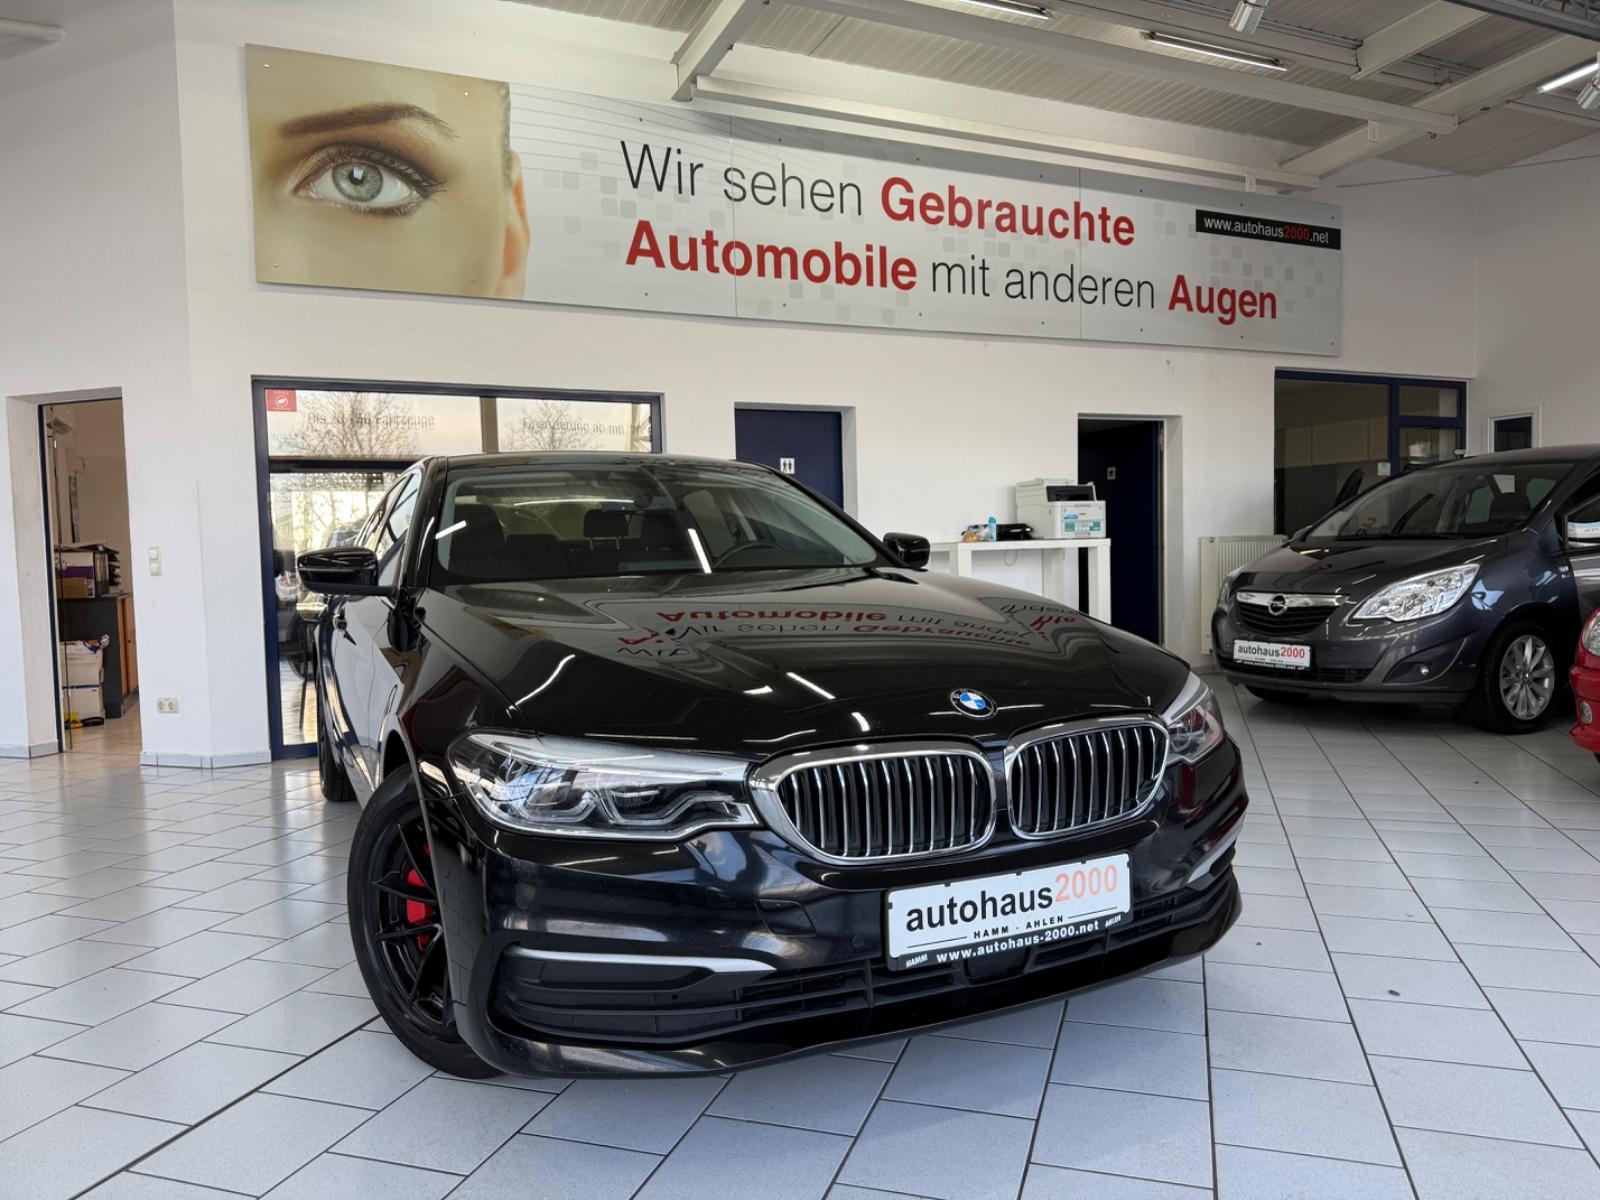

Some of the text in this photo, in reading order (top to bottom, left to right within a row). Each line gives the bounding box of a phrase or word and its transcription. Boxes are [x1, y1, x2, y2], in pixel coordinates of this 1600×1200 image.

[620, 140, 1136, 246] Wir sehen Gebrauchte
[1203, 217, 1330, 244] www.autohaus2000.net
[625, 219, 1278, 326] Automobile mit anderen Augen
[1237, 644, 1306, 659] autohaus2000
[906, 863, 1119, 932] autohaus2000
[936, 920, 1100, 963] www.autohaus-2000.net
[973, 925, 1010, 939] HAMM
[1026, 915, 1064, 930] AHLEN
